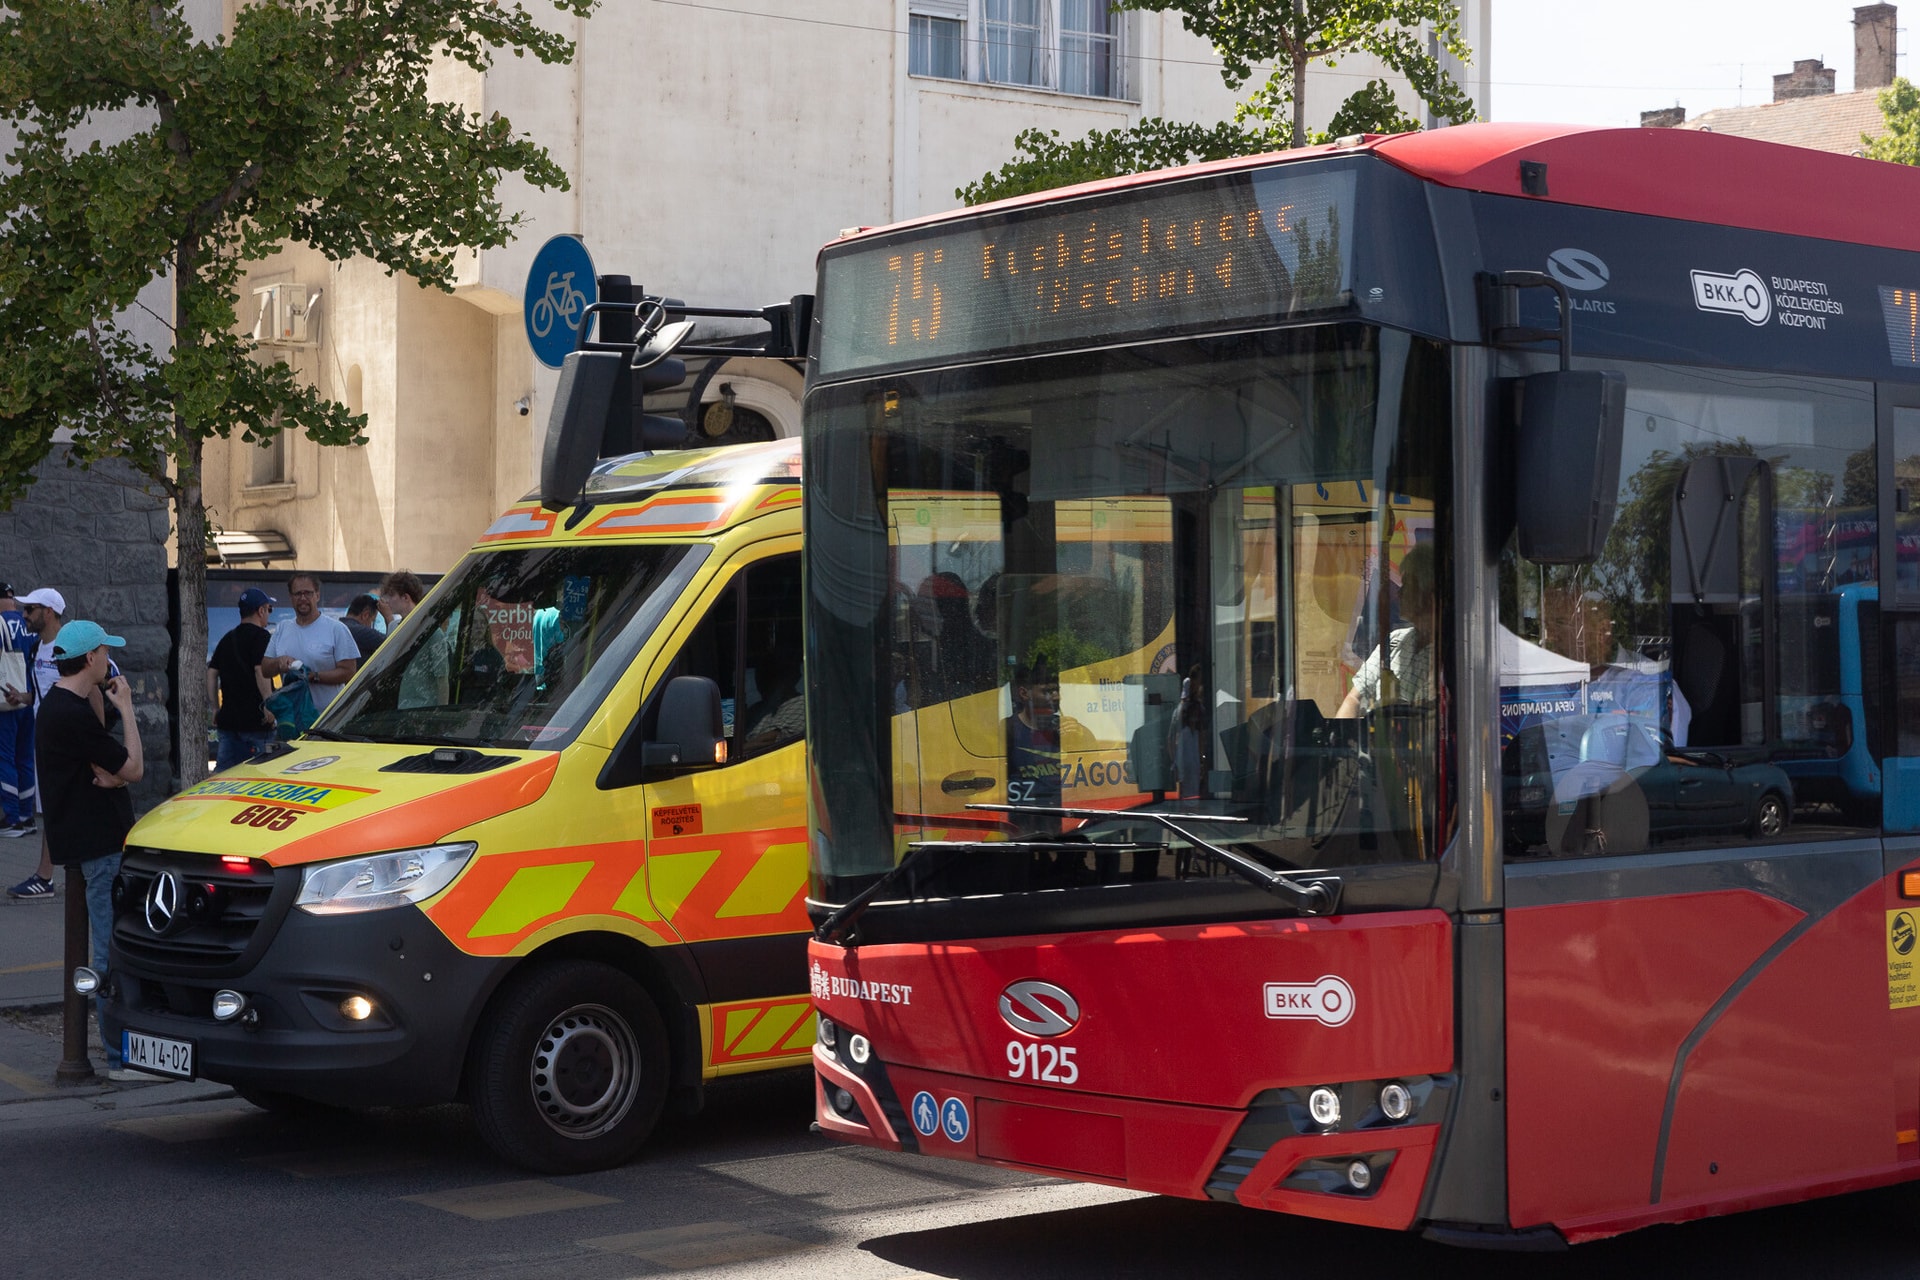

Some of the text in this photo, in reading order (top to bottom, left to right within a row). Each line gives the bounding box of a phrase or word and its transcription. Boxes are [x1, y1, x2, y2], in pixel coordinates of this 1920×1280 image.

[888, 248, 943, 346] 75
[1703, 283, 1738, 303] BKK
[1771, 276, 1829, 296] BUDAPESTI
[1775, 292, 1844, 315] KÖZLEKEDÉSI
[1778, 309, 1827, 330] KÖZPONT
[230, 804, 306, 832] 605
[653, 805, 700, 817] KÉPFELVÉTEL
[831, 976, 912, 1005] BUDAPEST
[1276, 993, 1312, 1008] BKK
[131, 1036, 189, 1072] MA 14-02
[1006, 1041, 1079, 1084] 9125
